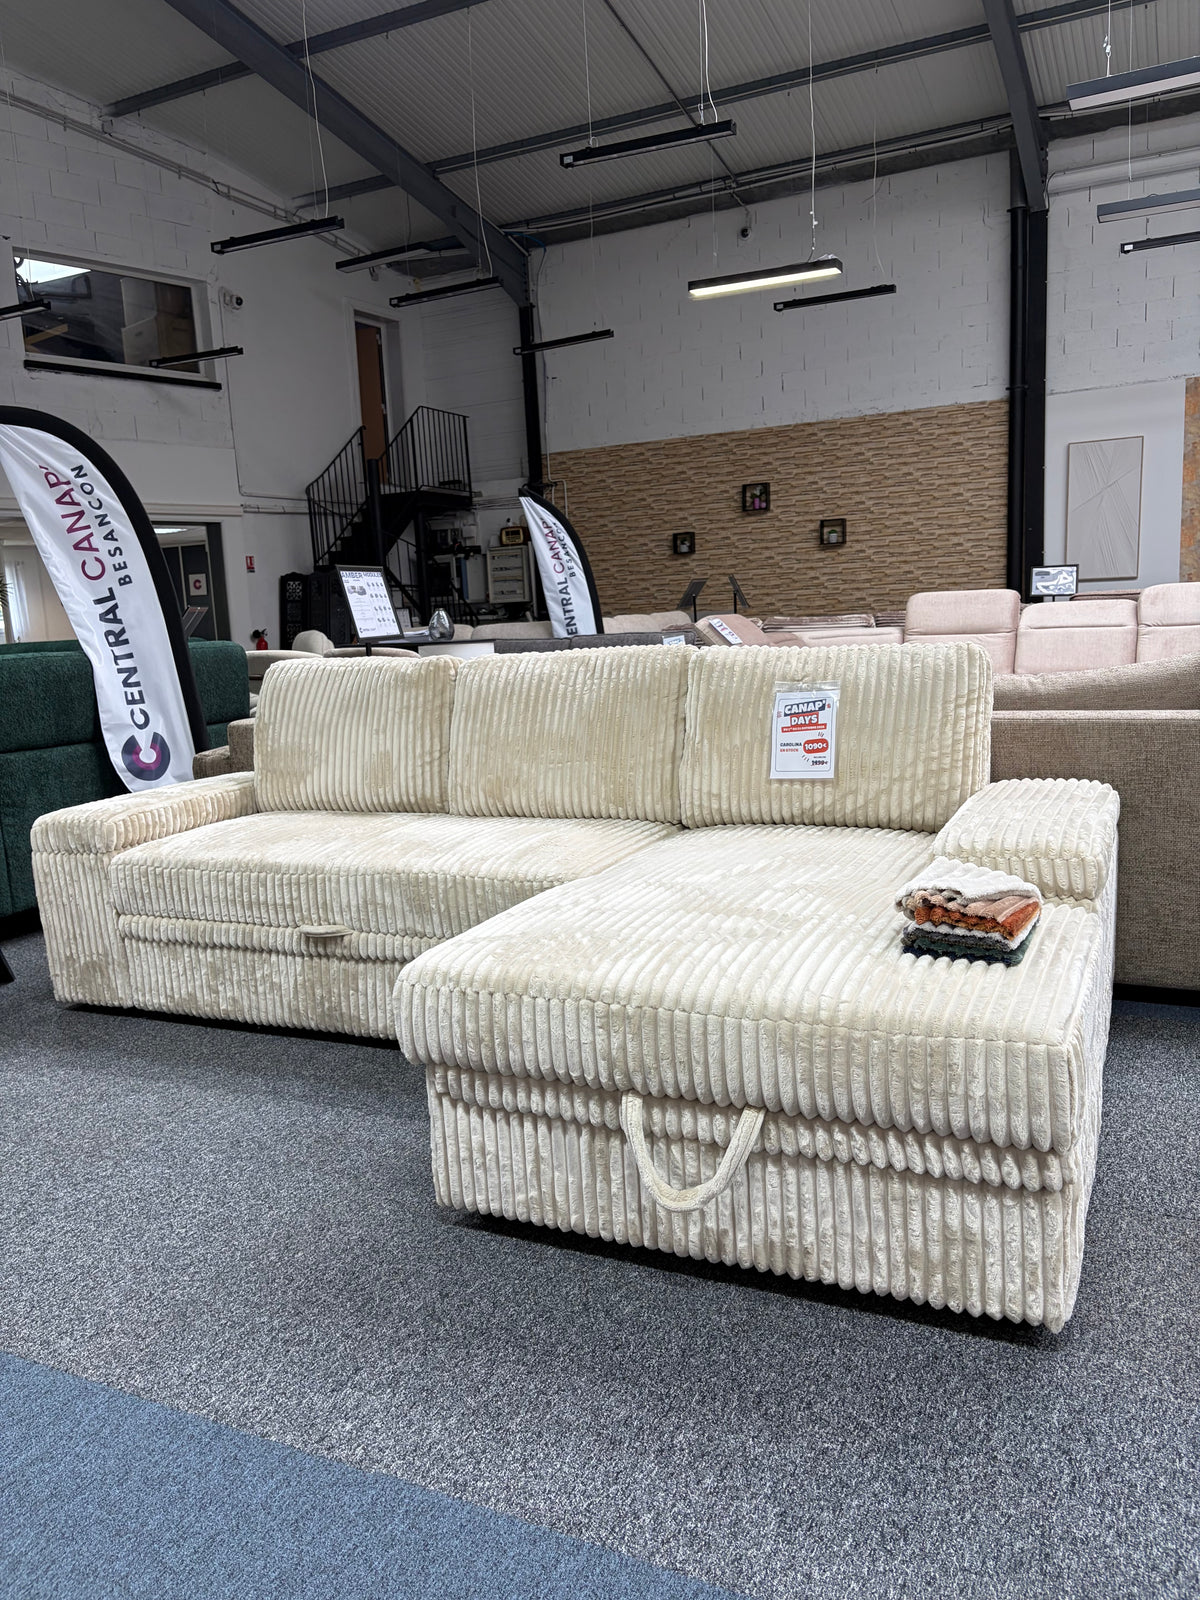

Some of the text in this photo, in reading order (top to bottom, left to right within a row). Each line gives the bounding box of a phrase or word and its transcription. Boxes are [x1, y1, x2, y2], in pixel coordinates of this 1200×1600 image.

[39, 465, 106, 581] CANAP'
[70, 464, 133, 587] BESANCON
[557, 577, 578, 636] ENTRAL
[93, 586, 150, 730] CENTRAL
[784, 700, 826, 715] CANAP'
[791, 714, 818, 726] DAYS
